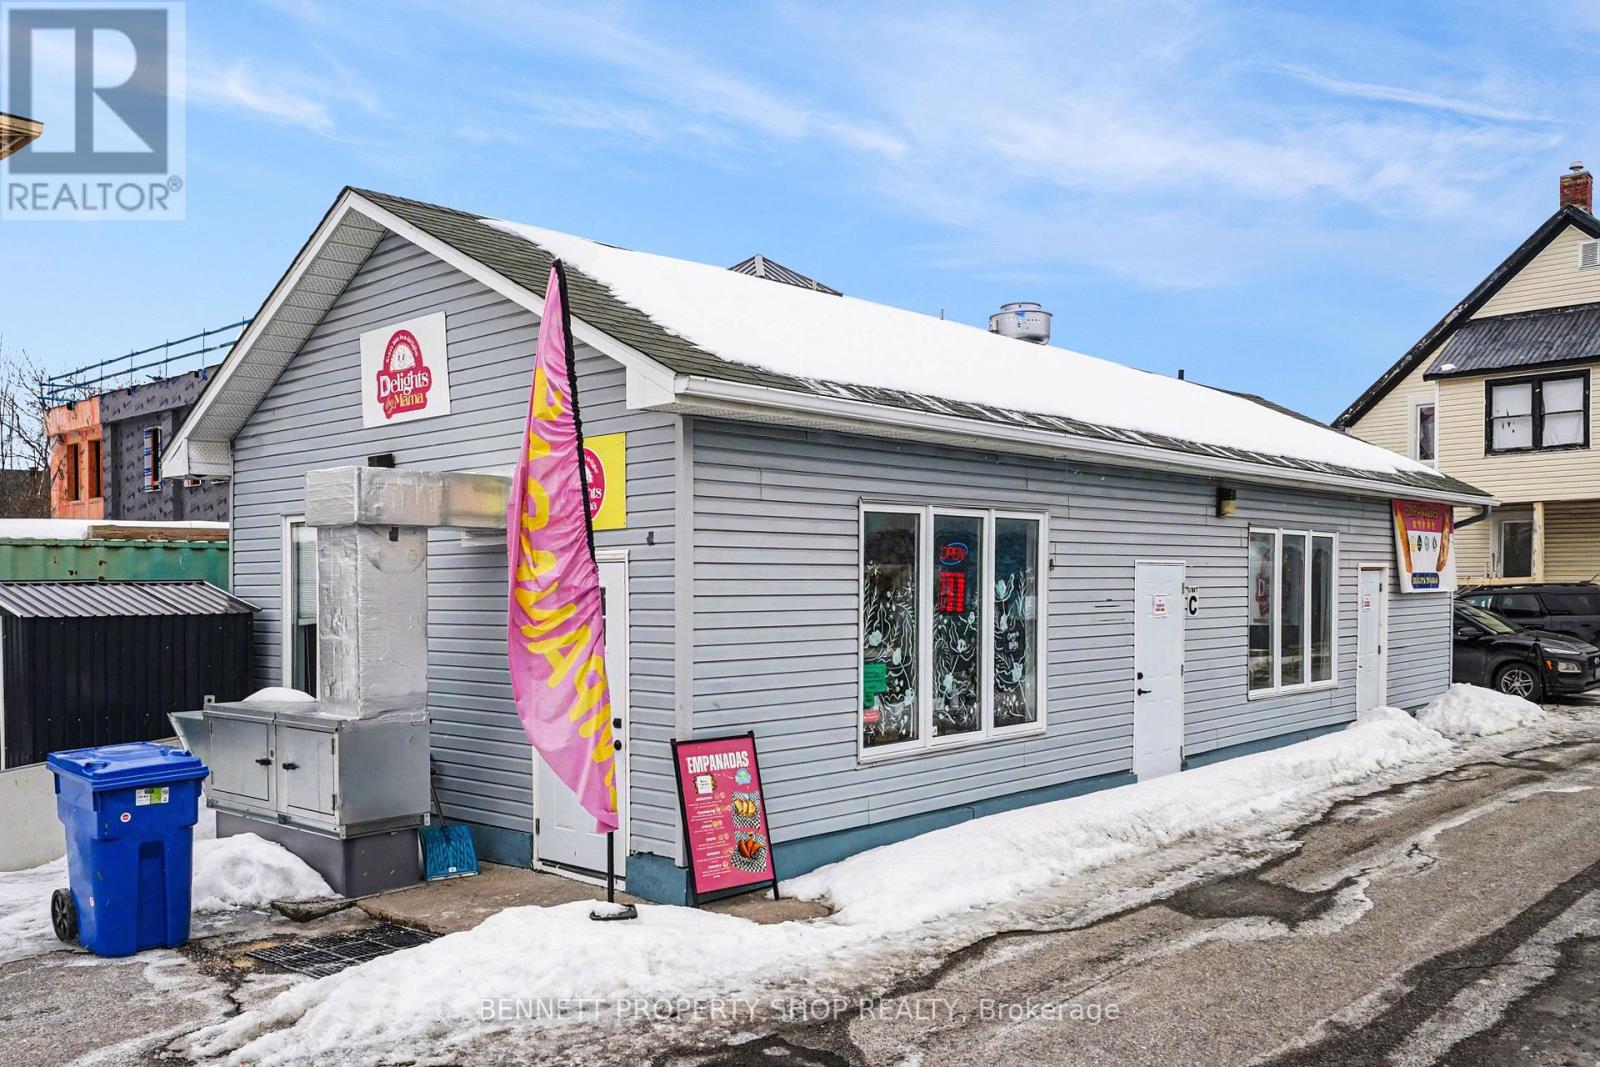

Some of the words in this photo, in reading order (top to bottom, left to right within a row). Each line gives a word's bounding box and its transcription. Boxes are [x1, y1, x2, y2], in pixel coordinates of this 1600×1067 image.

[379, 371, 429, 396] Delights
[394, 392, 424, 407] Mama
[941, 545, 966, 561] OPEN
[1188, 595, 1198, 615] C
[686, 751, 749, 774] EMPANADAS
